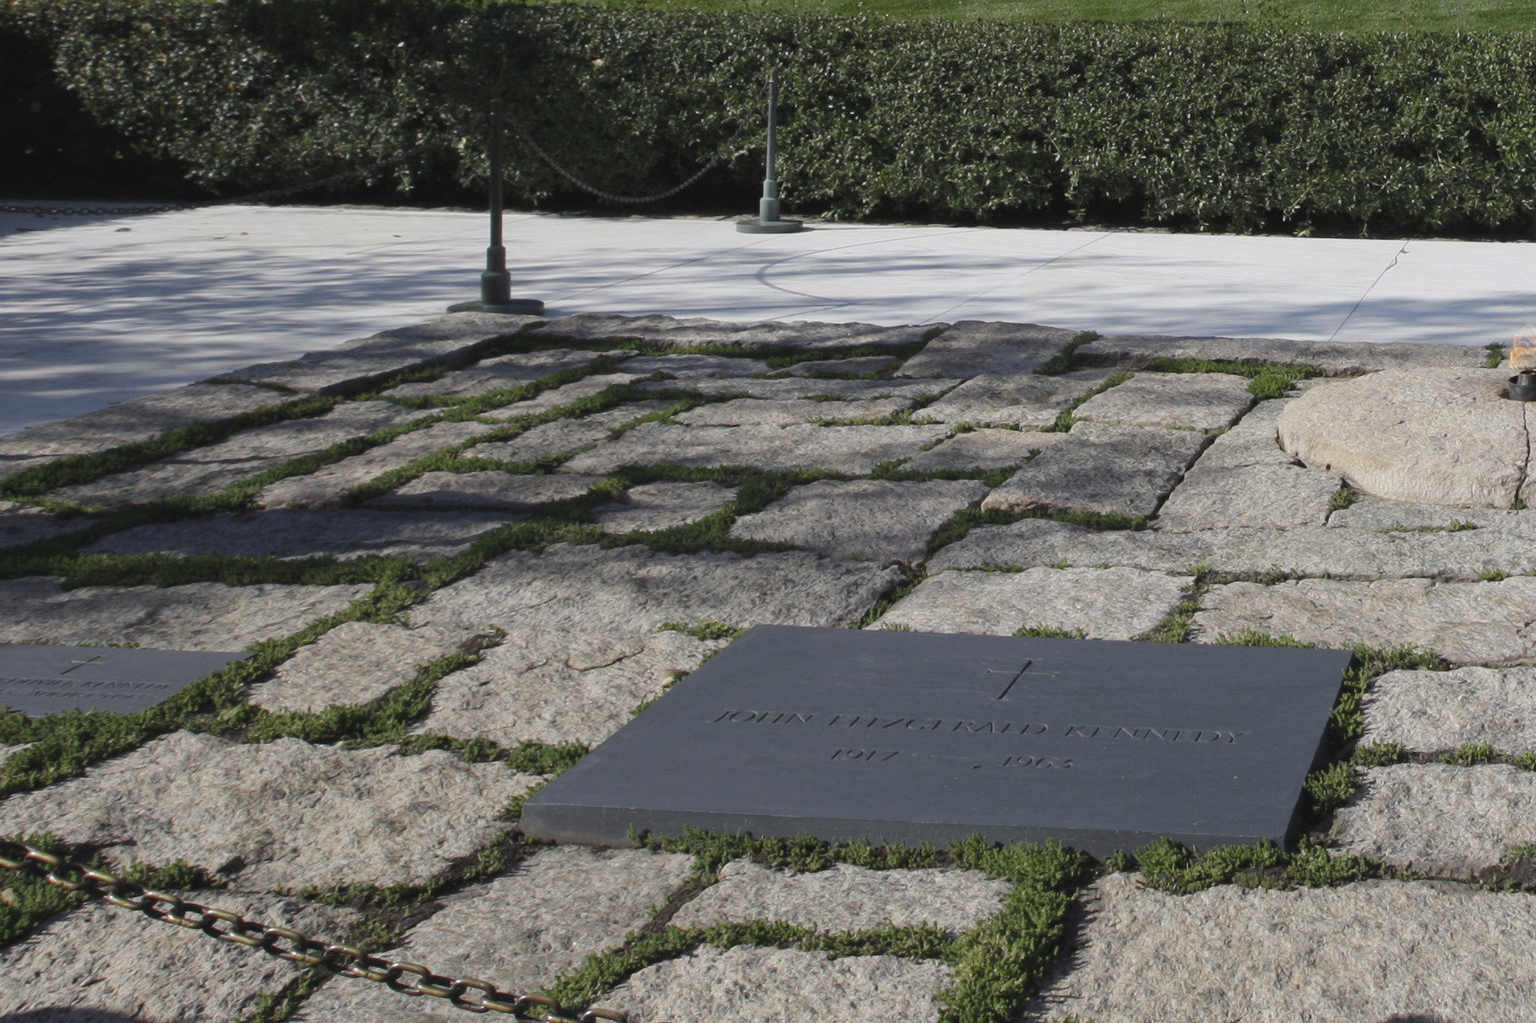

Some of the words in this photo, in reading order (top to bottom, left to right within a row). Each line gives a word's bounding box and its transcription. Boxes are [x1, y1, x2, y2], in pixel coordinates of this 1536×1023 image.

[706, 709, 815, 725] JOHN
[828, 714, 1049, 735] FITZGERALD
[1064, 725, 1249, 745] KENNEDY
[830, 747, 900, 762] 1917
[1001, 755, 1074, 770] 1963
